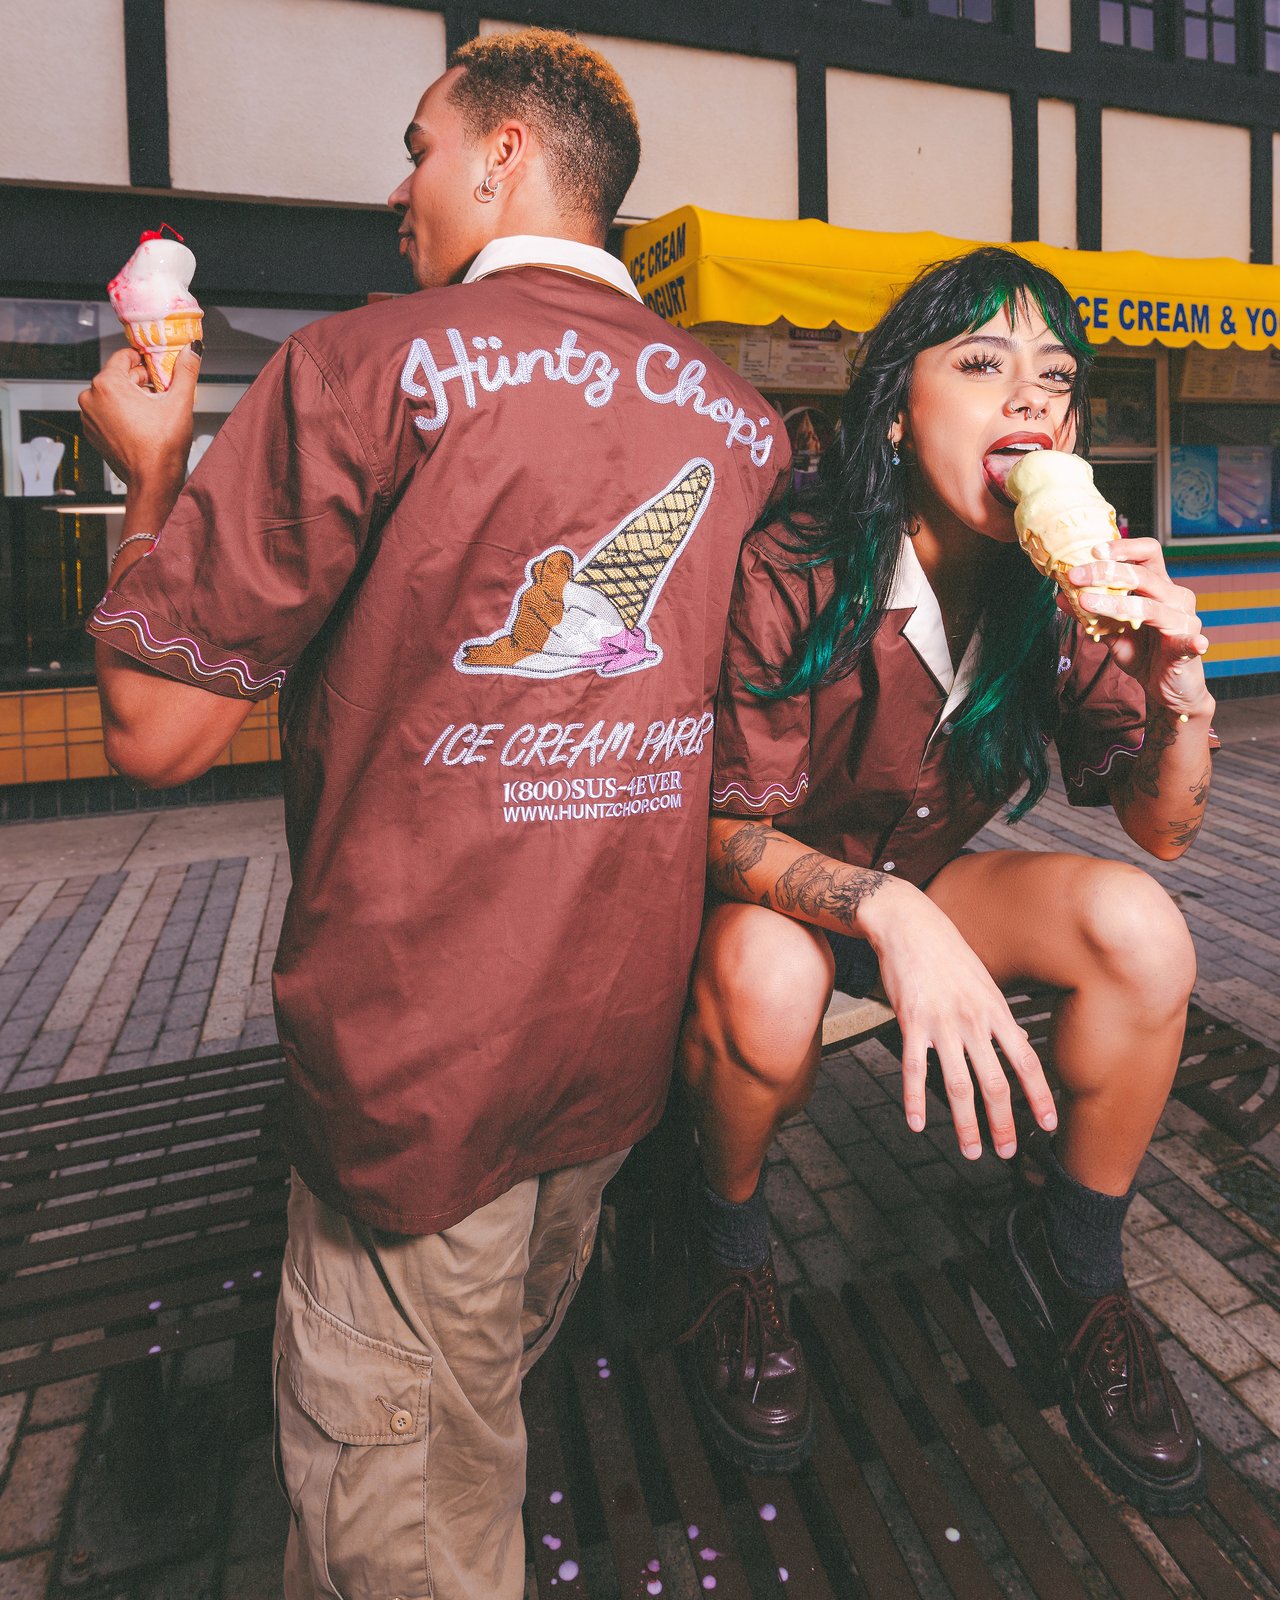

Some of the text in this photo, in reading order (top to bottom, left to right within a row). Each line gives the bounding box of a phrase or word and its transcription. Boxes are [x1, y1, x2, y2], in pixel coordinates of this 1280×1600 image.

[648, 222, 687, 278] CREAM
[643, 276, 688, 320] OGURT
[1075, 296, 1280, 337] CE CREAM & YO
[400, 328, 621, 431] Hüntz
[423, 722, 504, 766] ICE
[500, 719, 635, 768] CREAM
[503, 770, 683, 804] 1(800)SUS-4EVER
[503, 793, 682, 823] WWW.HUNTZCHOP.COM
